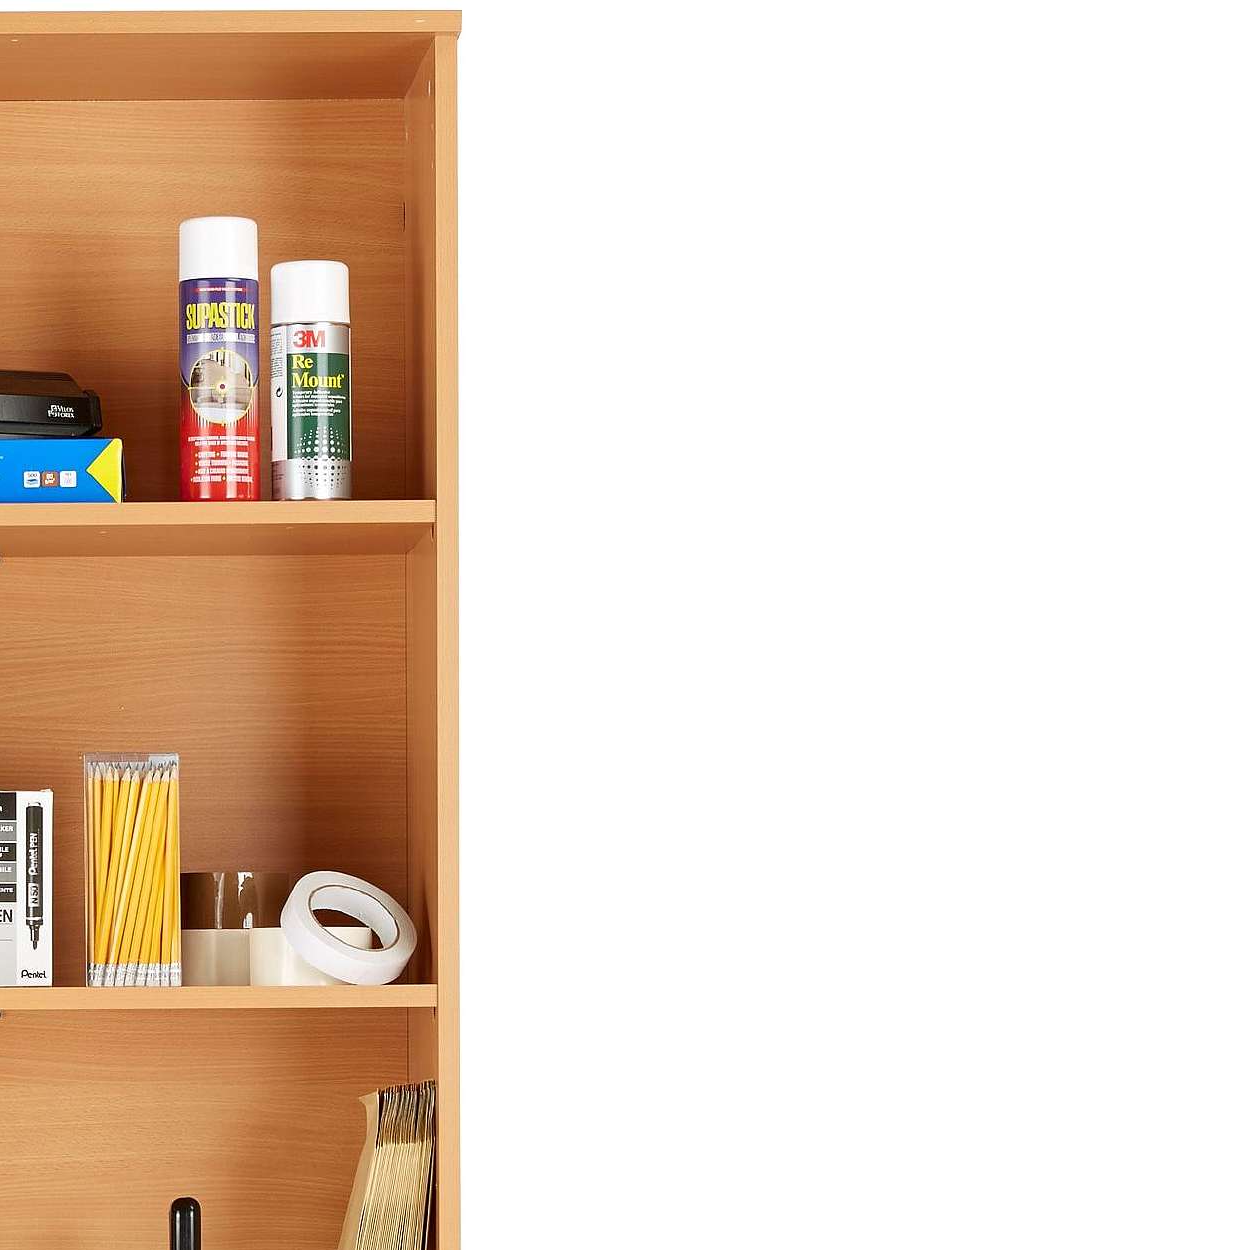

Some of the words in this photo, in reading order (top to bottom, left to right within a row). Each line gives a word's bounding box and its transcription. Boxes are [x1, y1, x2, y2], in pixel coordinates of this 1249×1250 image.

[186, 302, 255, 330] SUPASTICK
[293, 330, 327, 348] 3M
[292, 355, 314, 369] Re
[27, 848, 38, 875] Pentel
[21, 969, 47, 979] Pentel
